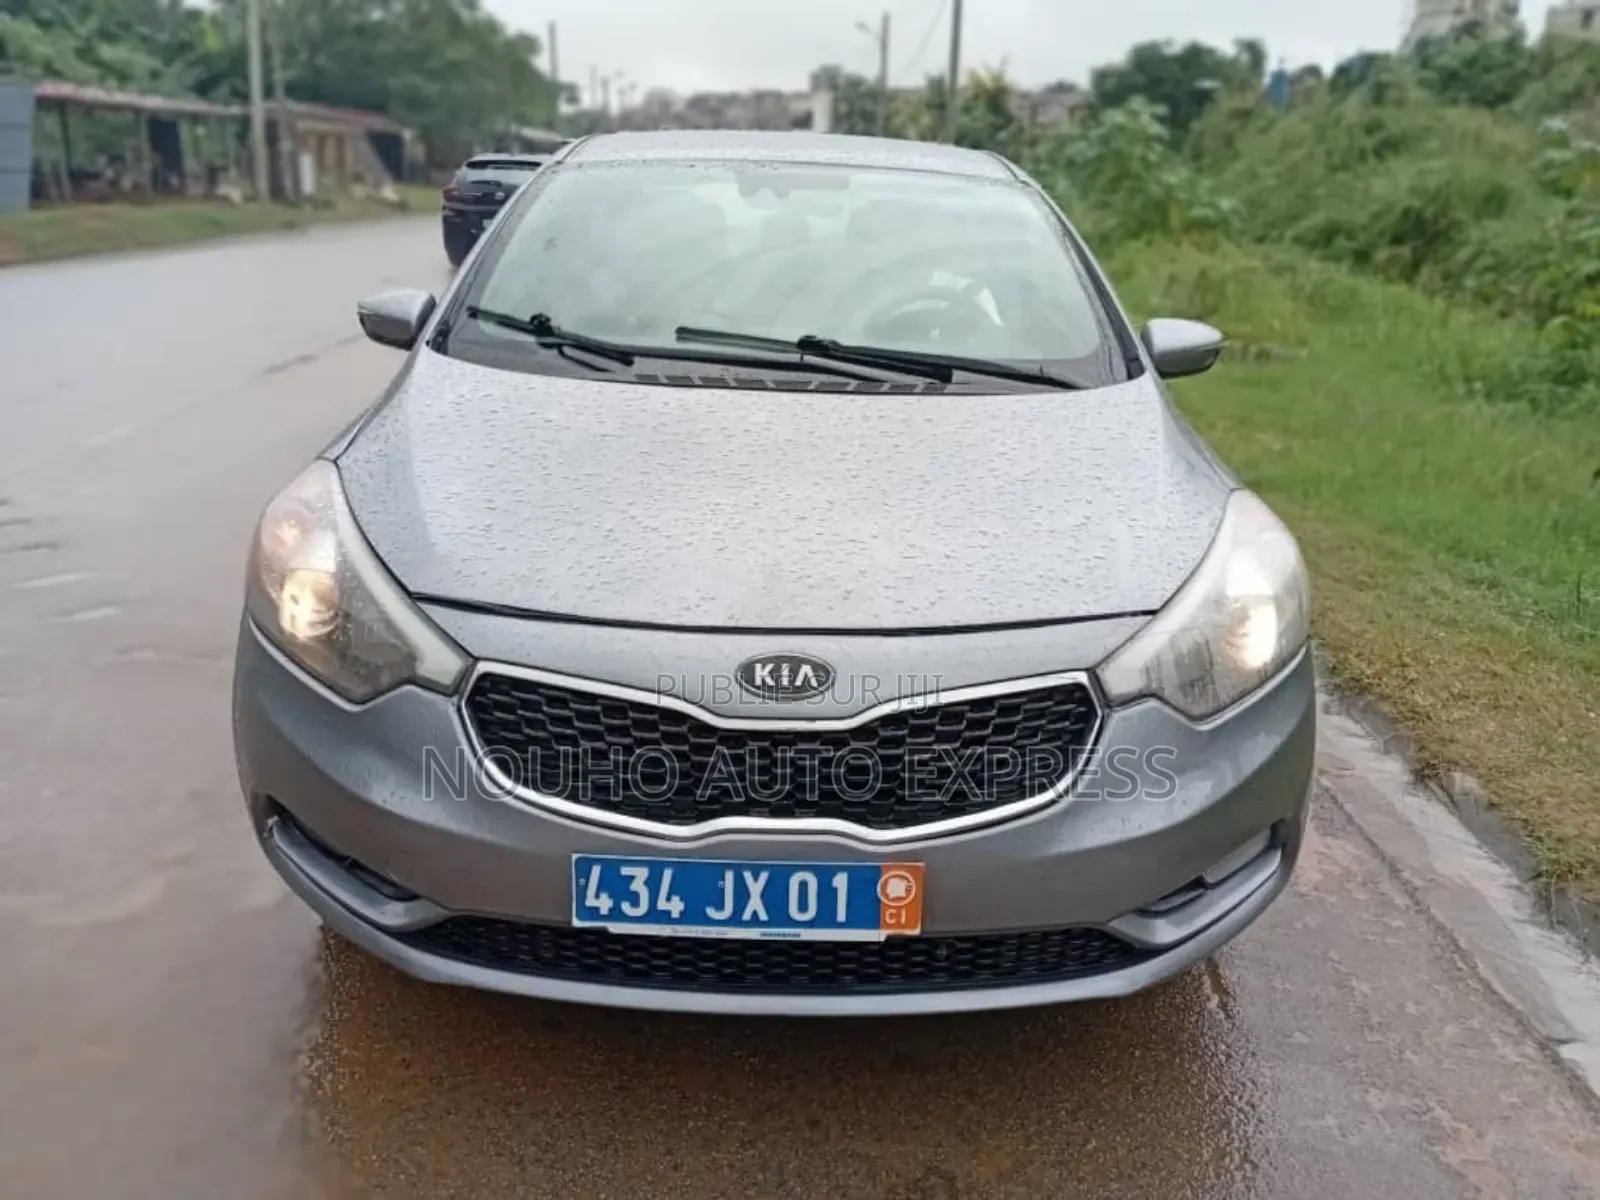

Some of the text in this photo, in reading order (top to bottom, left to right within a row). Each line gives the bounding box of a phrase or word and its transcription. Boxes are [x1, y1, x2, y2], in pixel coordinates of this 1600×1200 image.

[753, 663, 819, 688] KIA
[584, 864, 849, 924] 434 JX 01
[884, 907, 907, 925] CI
